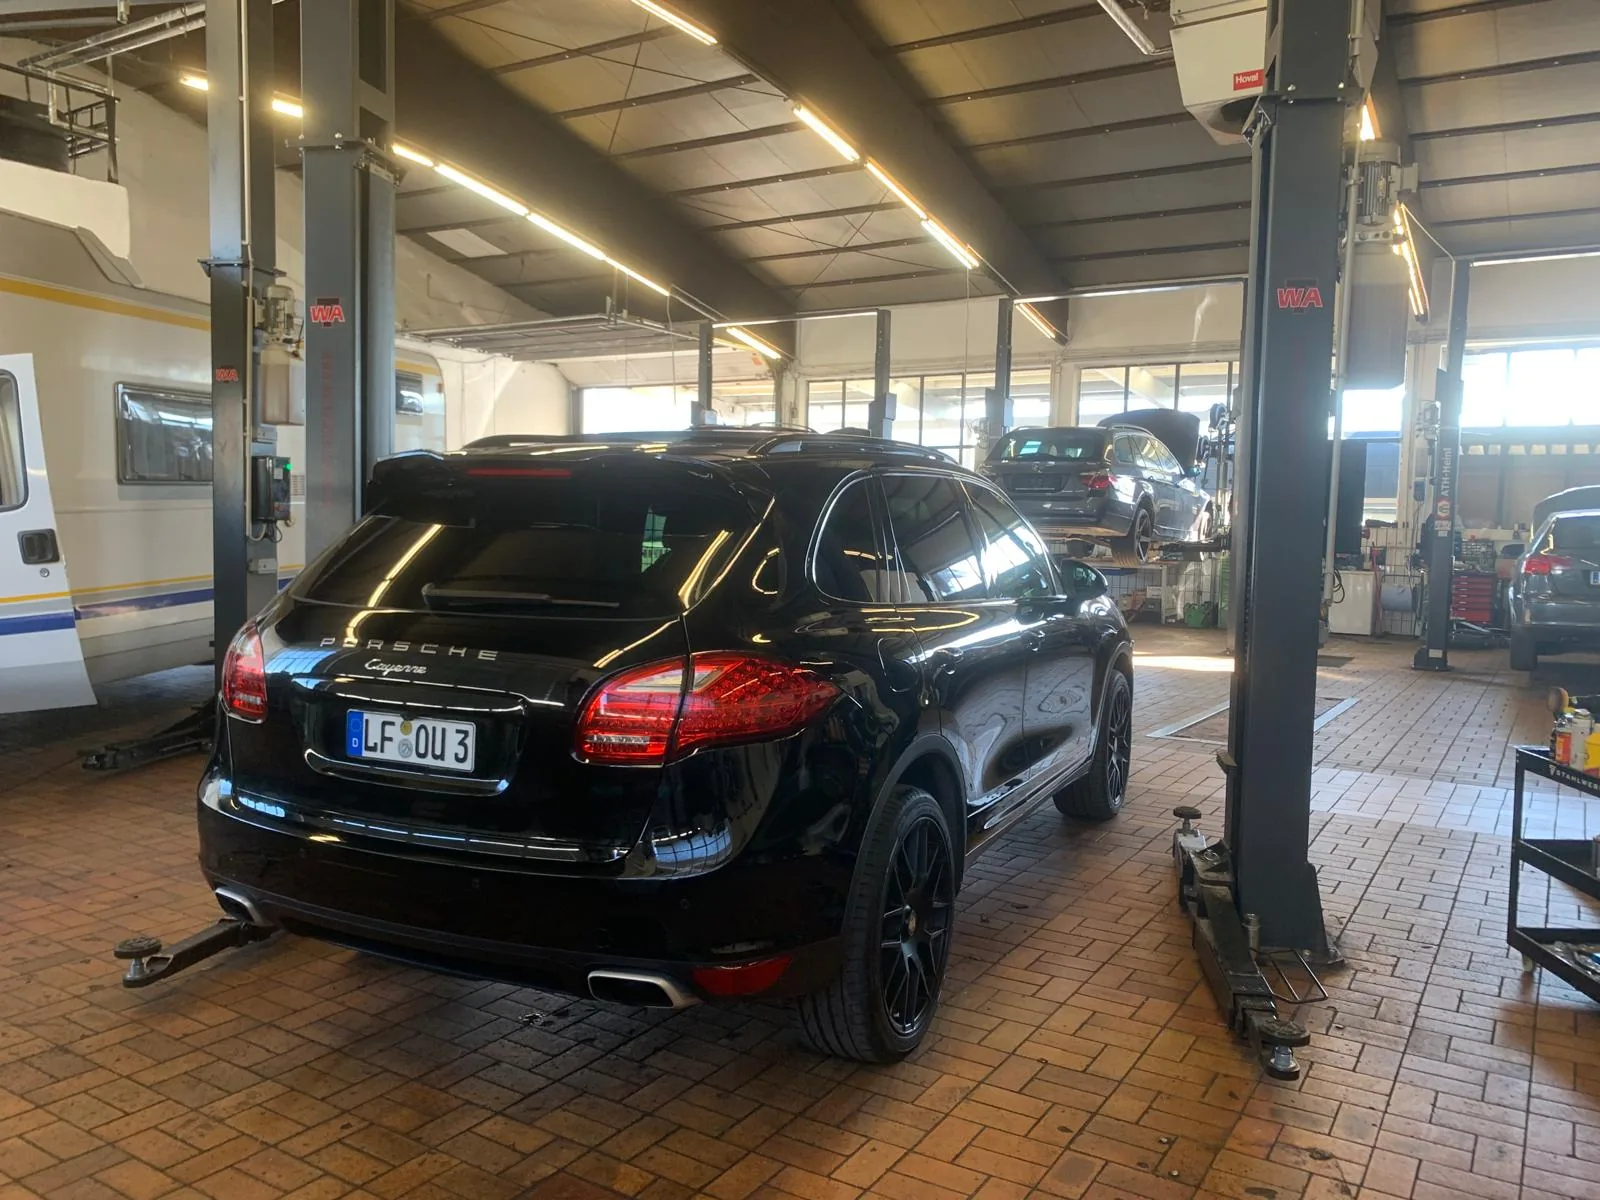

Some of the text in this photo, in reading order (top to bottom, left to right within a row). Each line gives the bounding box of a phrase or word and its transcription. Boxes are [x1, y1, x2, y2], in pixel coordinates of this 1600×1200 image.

[1235, 72, 1259, 84] Hoval
[1277, 287, 1323, 308] WA
[310, 304, 345, 323] WA
[320, 637, 499, 661] PORSCHE
[364, 658, 428, 676] Cayenne
[351, 737, 359, 748] D
[364, 718, 469, 763] LF OU 3
[1556, 769, 1600, 790] STAHLWER
